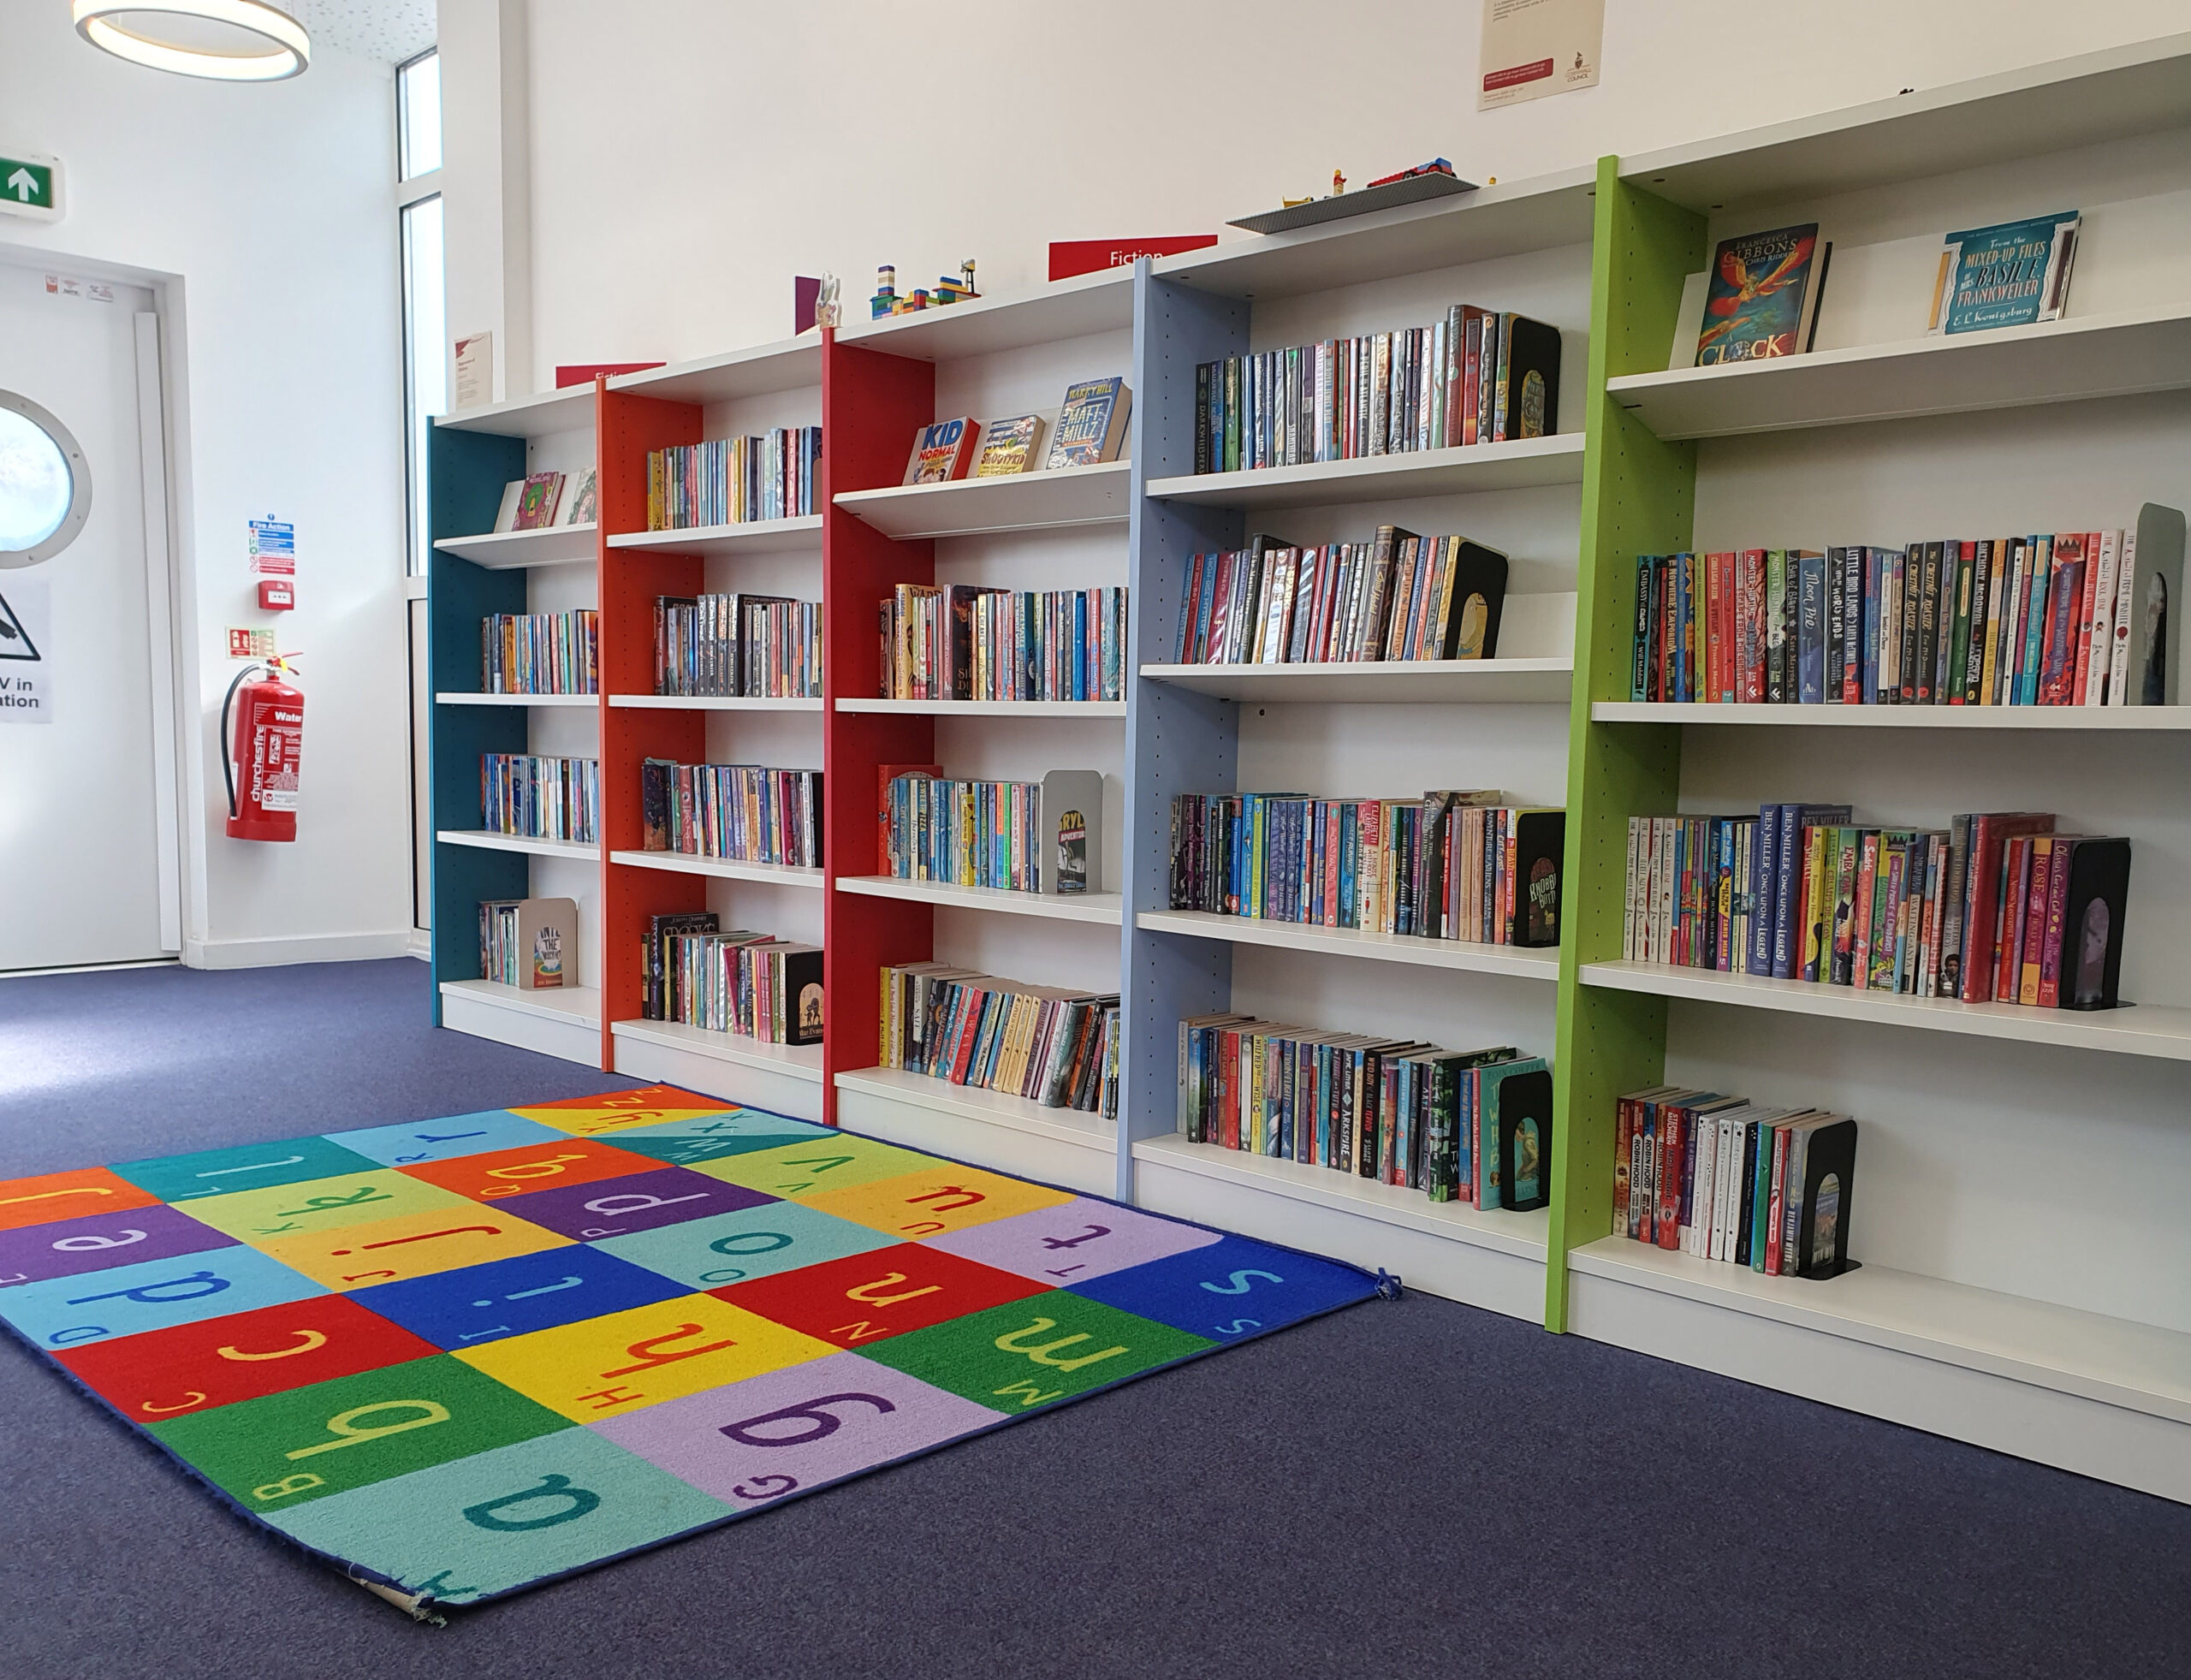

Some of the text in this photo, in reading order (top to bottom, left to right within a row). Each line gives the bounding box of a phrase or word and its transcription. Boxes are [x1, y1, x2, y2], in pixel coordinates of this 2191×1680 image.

[1724, 239, 1797, 264] GIBBONS
[1736, 233, 1788, 250] FRANCESCA
[1964, 240, 2046, 269] MIXED-UP FILES
[1991, 239, 2010, 249] From
[1976, 260, 2024, 288] BASIL
[1957, 280, 2040, 308] FRANKWEILER
[1067, 403, 1102, 424] MATT
[922, 419, 964, 449] KID
[1198, 405, 1207, 474] DARKWHISPERS
[918, 445, 955, 461] NORMAL
[268, 522, 290, 531] Action
[1284, 571, 1294, 604] SPARK
[1375, 572, 1384, 591] Shad
[1640, 570, 1651, 602] EMBASSY
[1747, 555, 1756, 616] MONSTER HUNTING
[1772, 556, 1781, 620] MONSTER HUNTING
[1847, 550, 1859, 618] LITTLE BIRD LANDS
[1973, 543, 1987, 626] ANTHONY McGOWAN
[1803, 570, 1820, 629] Moon Pie
[1905, 564, 1920, 631] CHESTNUT ROASTER
[1921, 562, 1937, 631] CHESTNUT ROASTER
[1666, 568, 1677, 655] NOWHERE EMPORIUM
[1832, 588, 1843, 638] WORLD ENDS
[17, 677, 33, 691] in
[275, 711, 302, 723] Water
[252, 726, 264, 802] churchesfire
[1370, 805, 1380, 843] ELIZABETH
[1486, 811, 1494, 855] ADVENTURE
[1762, 811, 1773, 868] BEN MILLER
[1782, 812, 1793, 870] BEN MILLER
[1844, 846, 1855, 874] EMBA
[1864, 846, 1874, 871] Sedric
[1529, 873, 1556, 902] KNOBB
[2034, 856, 2047, 892] ROSE
[1824, 905, 1832, 940] DRAGON
[1905, 897, 1919, 968] WAITING ANYA
[2030, 918, 2040, 938] HOLLY
[543, 939, 558, 950] THE
[1757, 928, 1768, 959] LEGEND
[1776, 929, 1787, 961] LEGEND
[1254, 1039, 1262, 1069] WILFRED
[602, 1095, 646, 1107] z
[644, 1087, 663, 1096] Z
[595, 1110, 664, 1126] y
[690, 1122, 739, 1134] x
[721, 1112, 754, 1121] X
[415, 1130, 488, 1143] r
[1341, 1109, 1352, 1155] ARKSPIRE
[195, 1155, 305, 1178] l
[395, 1151, 432, 1164] R
[485, 1153, 588, 1179] q
[781, 1155, 855, 1173] v
[181, 1186, 222, 1196] L
[276, 1186, 395, 1216] k
[479, 1184, 521, 1196] Q
[776, 1182, 814, 1193] V
[905, 1185, 987, 1213] u
[584, 1191, 711, 1215] p
[52, 1229, 147, 1252] e
[256, 1221, 303, 1234] K
[331, 1226, 502, 1256] j
[580, 1226, 627, 1240] P
[899, 1220, 946, 1236] U
[1042, 1224, 1113, 1250] t
[1784, 1210, 1796, 1263] BENJAMIN MYERS
[709, 1232, 794, 1256] o
[342, 1269, 396, 1282] J
[698, 1268, 746, 1283] O
[1046, 1263, 1086, 1277] T
[1199, 1269, 1285, 1295] s
[67, 1271, 231, 1304] d
[472, 1275, 585, 1308] i
[846, 1272, 945, 1307] n
[49, 1326, 110, 1344] D
[459, 1324, 511, 1342] I
[828, 1320, 892, 1341] N
[1214, 1318, 1262, 1335] S
[217, 1329, 327, 1361] c
[600, 1322, 739, 1379] h
[994, 1316, 1131, 1374] m
[142, 1391, 206, 1412] C
[575, 1386, 646, 1410] H
[991, 1379, 1066, 1406] M
[284, 1398, 451, 1460] b
[718, 1392, 897, 1448] g
[252, 1472, 325, 1501] B
[732, 1472, 800, 1500] G
[462, 1473, 603, 1532] a
